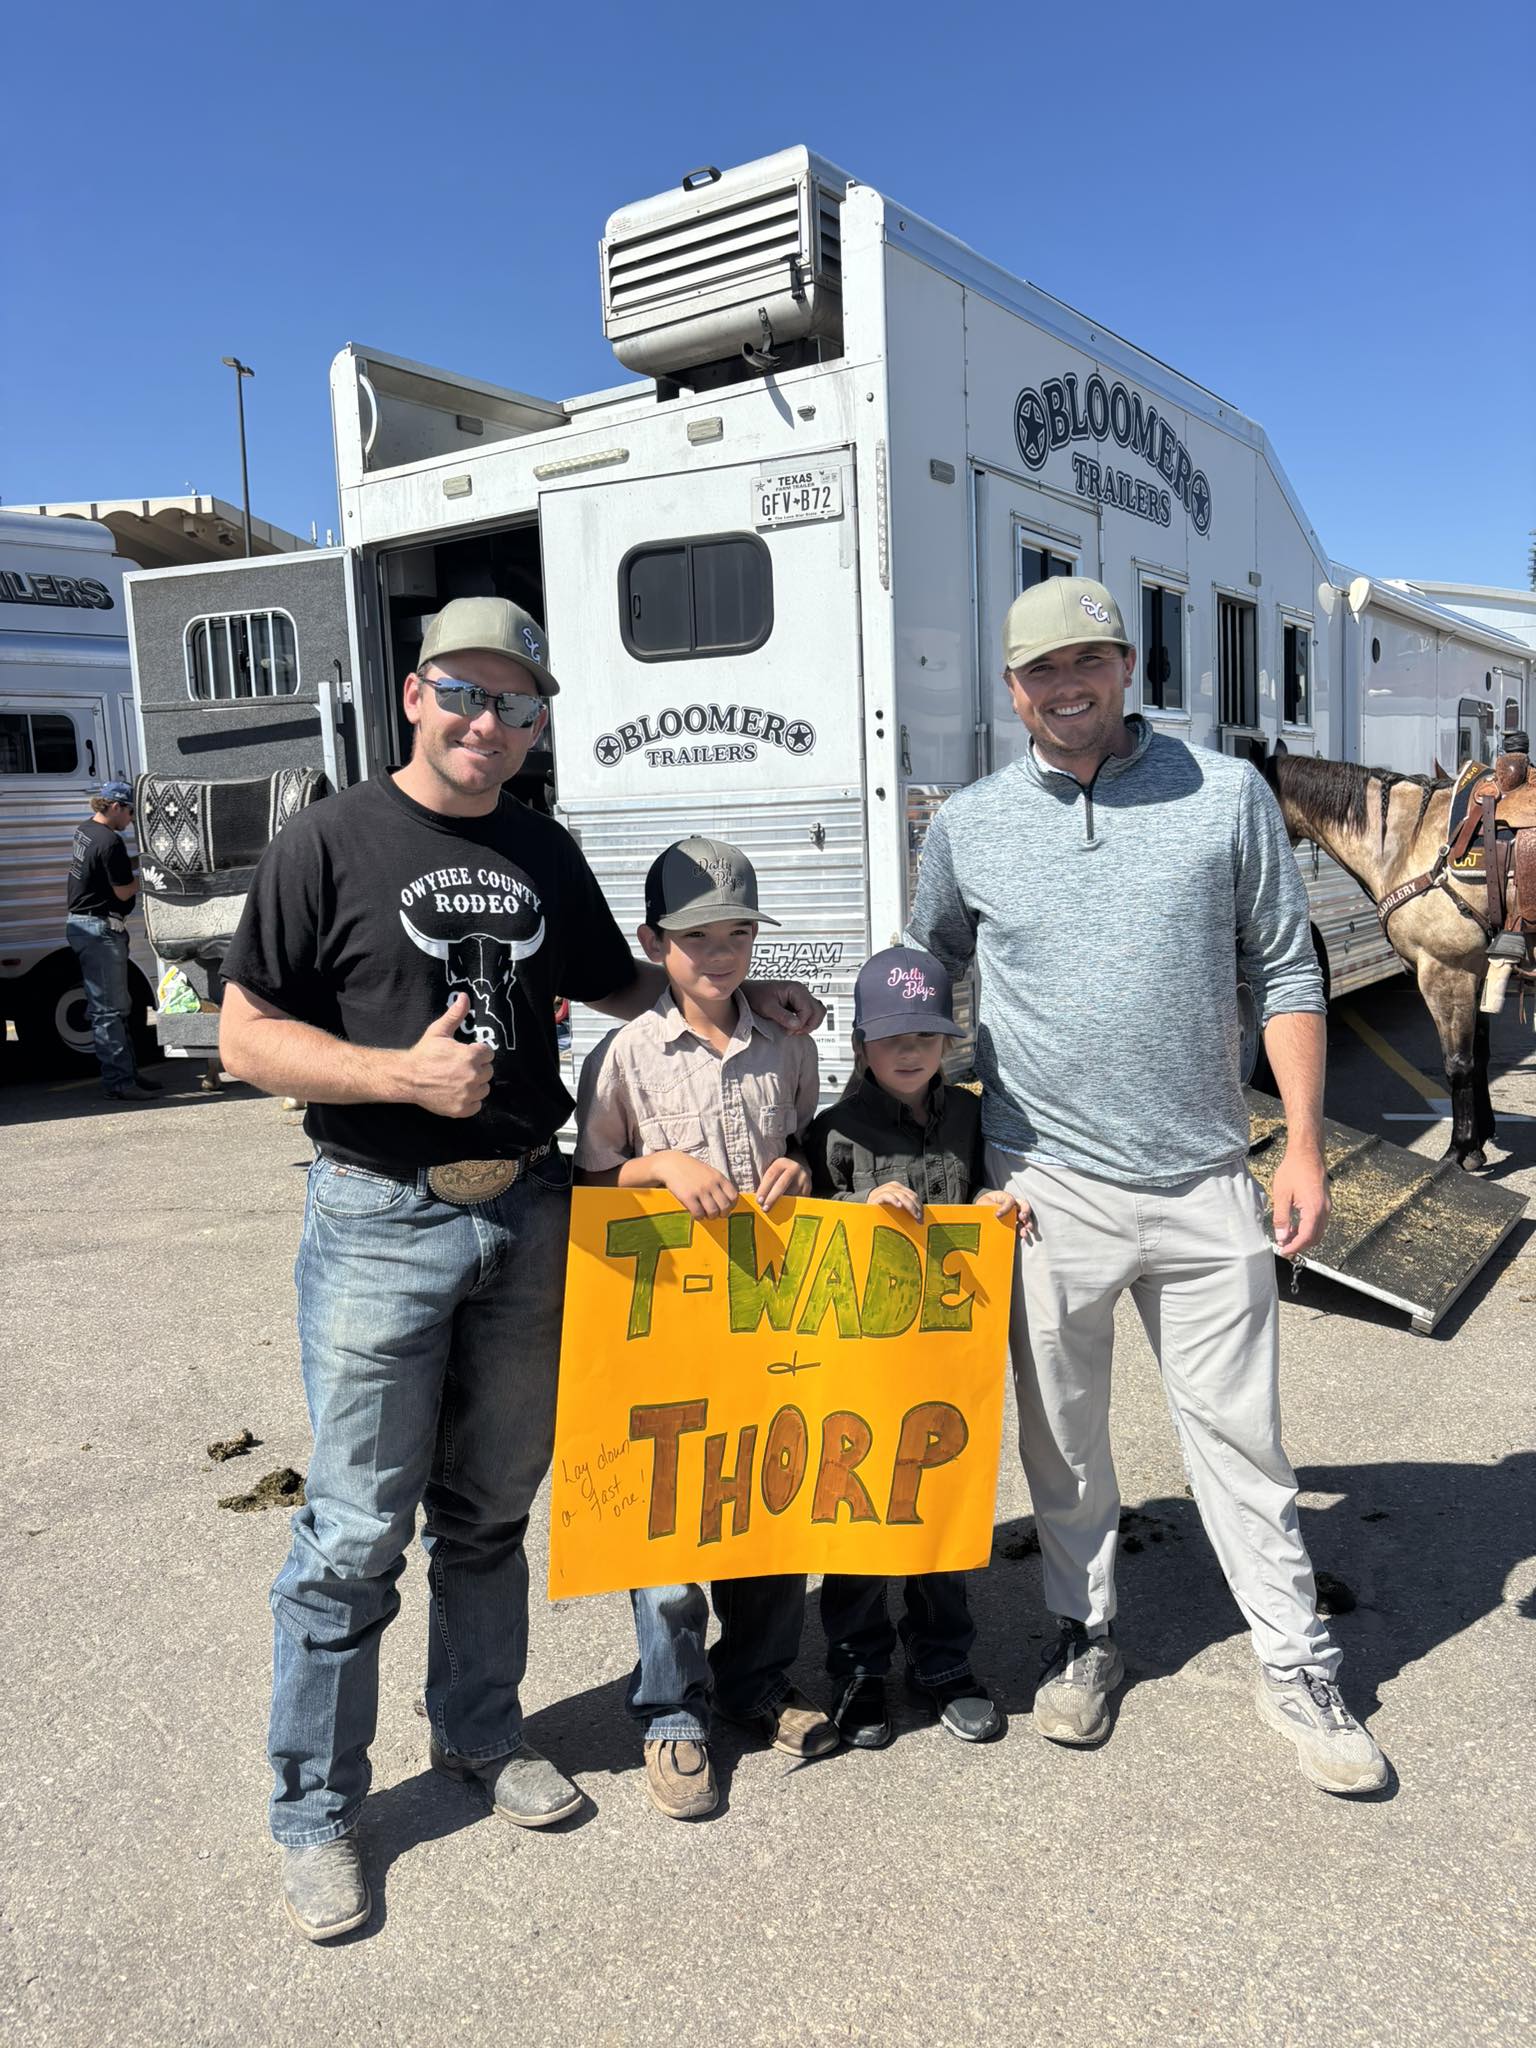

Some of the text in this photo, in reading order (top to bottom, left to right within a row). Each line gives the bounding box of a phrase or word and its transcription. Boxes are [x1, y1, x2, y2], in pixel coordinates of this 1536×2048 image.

[1041, 372, 1193, 513] BLOOMER
[778, 472, 813, 486] TEXAS
[1072, 452, 1171, 528] TRAILERS
[616, 703, 787, 754] BLOOMER
[645, 743, 758, 768] TRAILERS
[400, 867, 541, 914] OWYHEE COUNTY
[434, 893, 520, 915] RODEO
[1378, 882, 1417, 921] ADDLERY
[887, 967, 925, 986] Dally
[902, 980, 936, 1002] Boyz
[606, 1211, 981, 1340] T-WADE
[562, 1440, 630, 1499] Lay down
[629, 1399, 969, 1547] THORP
[561, 1474, 622, 1528] a fast
